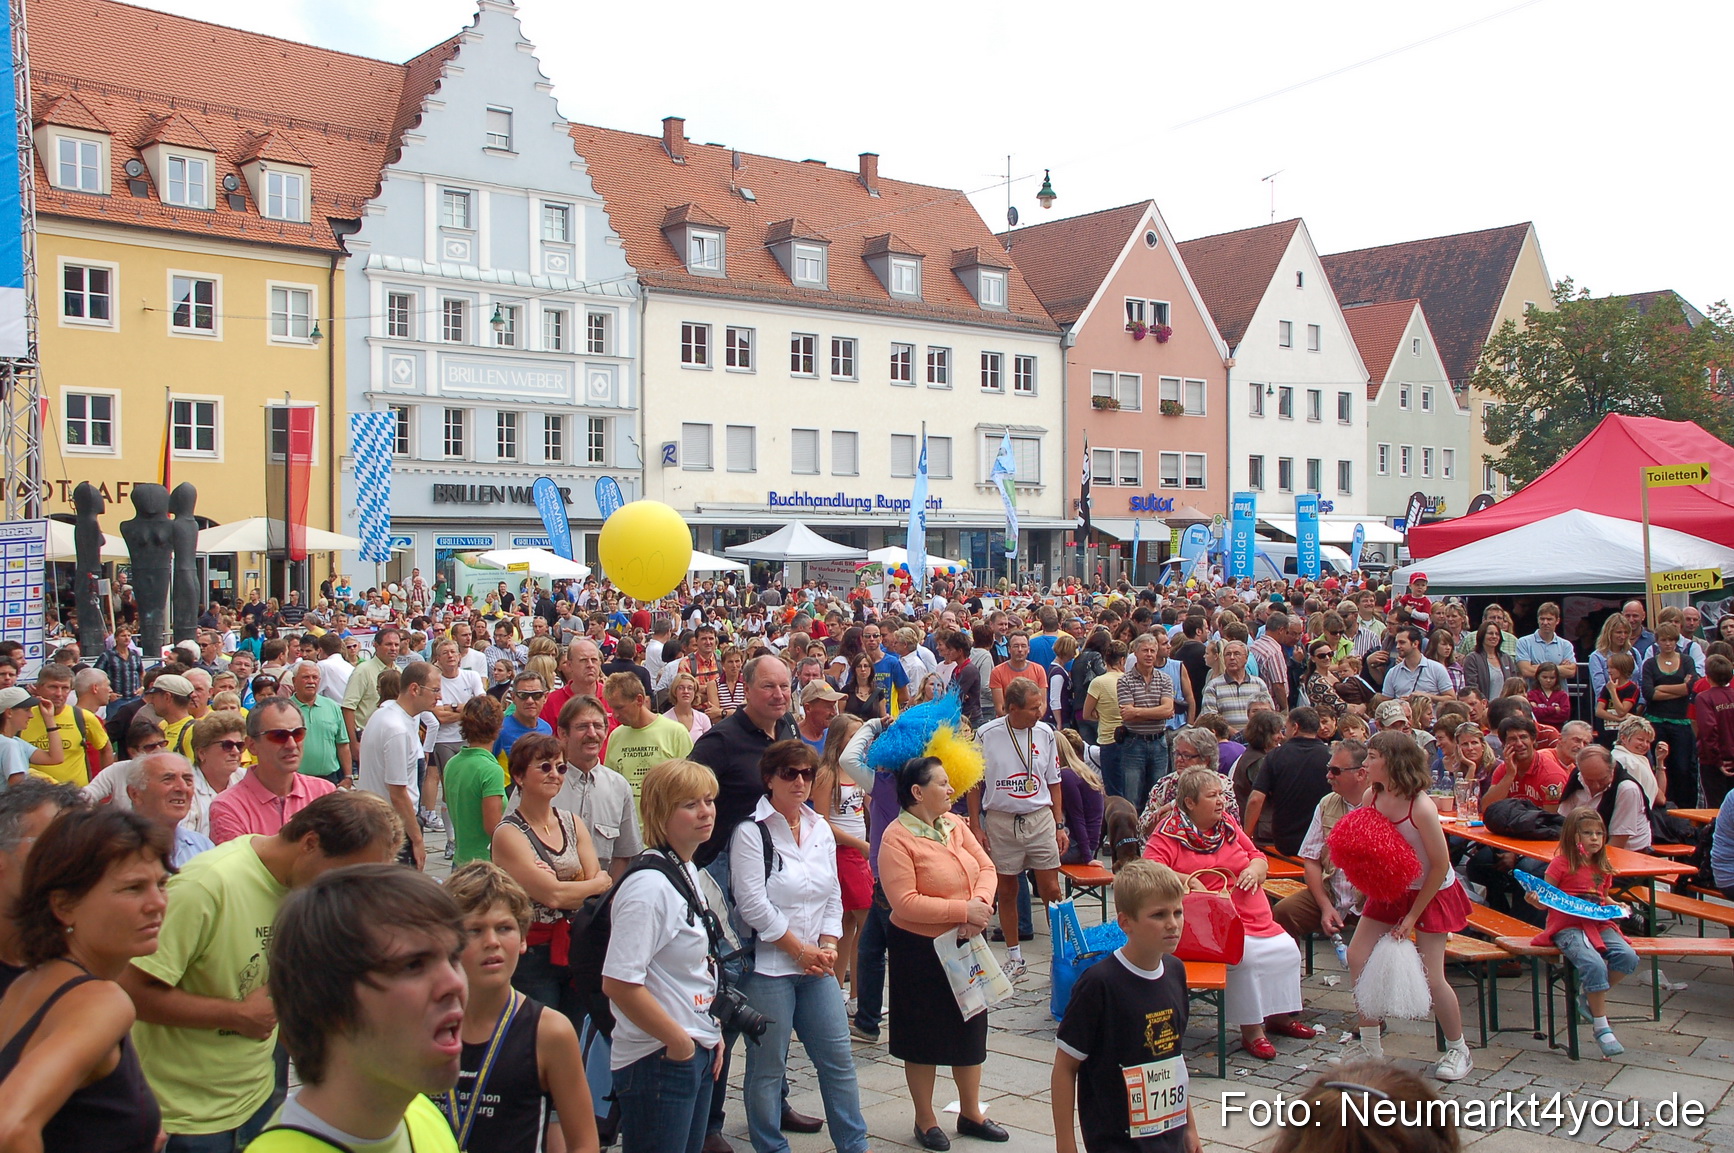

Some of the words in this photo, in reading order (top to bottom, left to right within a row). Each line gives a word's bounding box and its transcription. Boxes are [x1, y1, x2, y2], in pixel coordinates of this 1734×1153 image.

[448, 366, 508, 386] BRILLEN
[510, 371, 564, 389] WEBER
[663, 444, 677, 464] R
[1647, 471, 1698, 482] Toiletten
[433, 483, 505, 505] BRILLEN
[508, 486, 574, 505] WER
[768, 491, 872, 512] Buchhandlung
[875, 494, 942, 513] Ruppcht
[440, 537, 467, 546] BRILLEN
[467, 537, 490, 546] WEBER
[1663, 572, 1702, 581] Kinder-
[1656, 581, 1710, 592] betreuung
[969, 963, 981, 978] dm
[1147, 1068, 1171, 1083] Moritz
[1150, 1084, 1185, 1111] 7158
